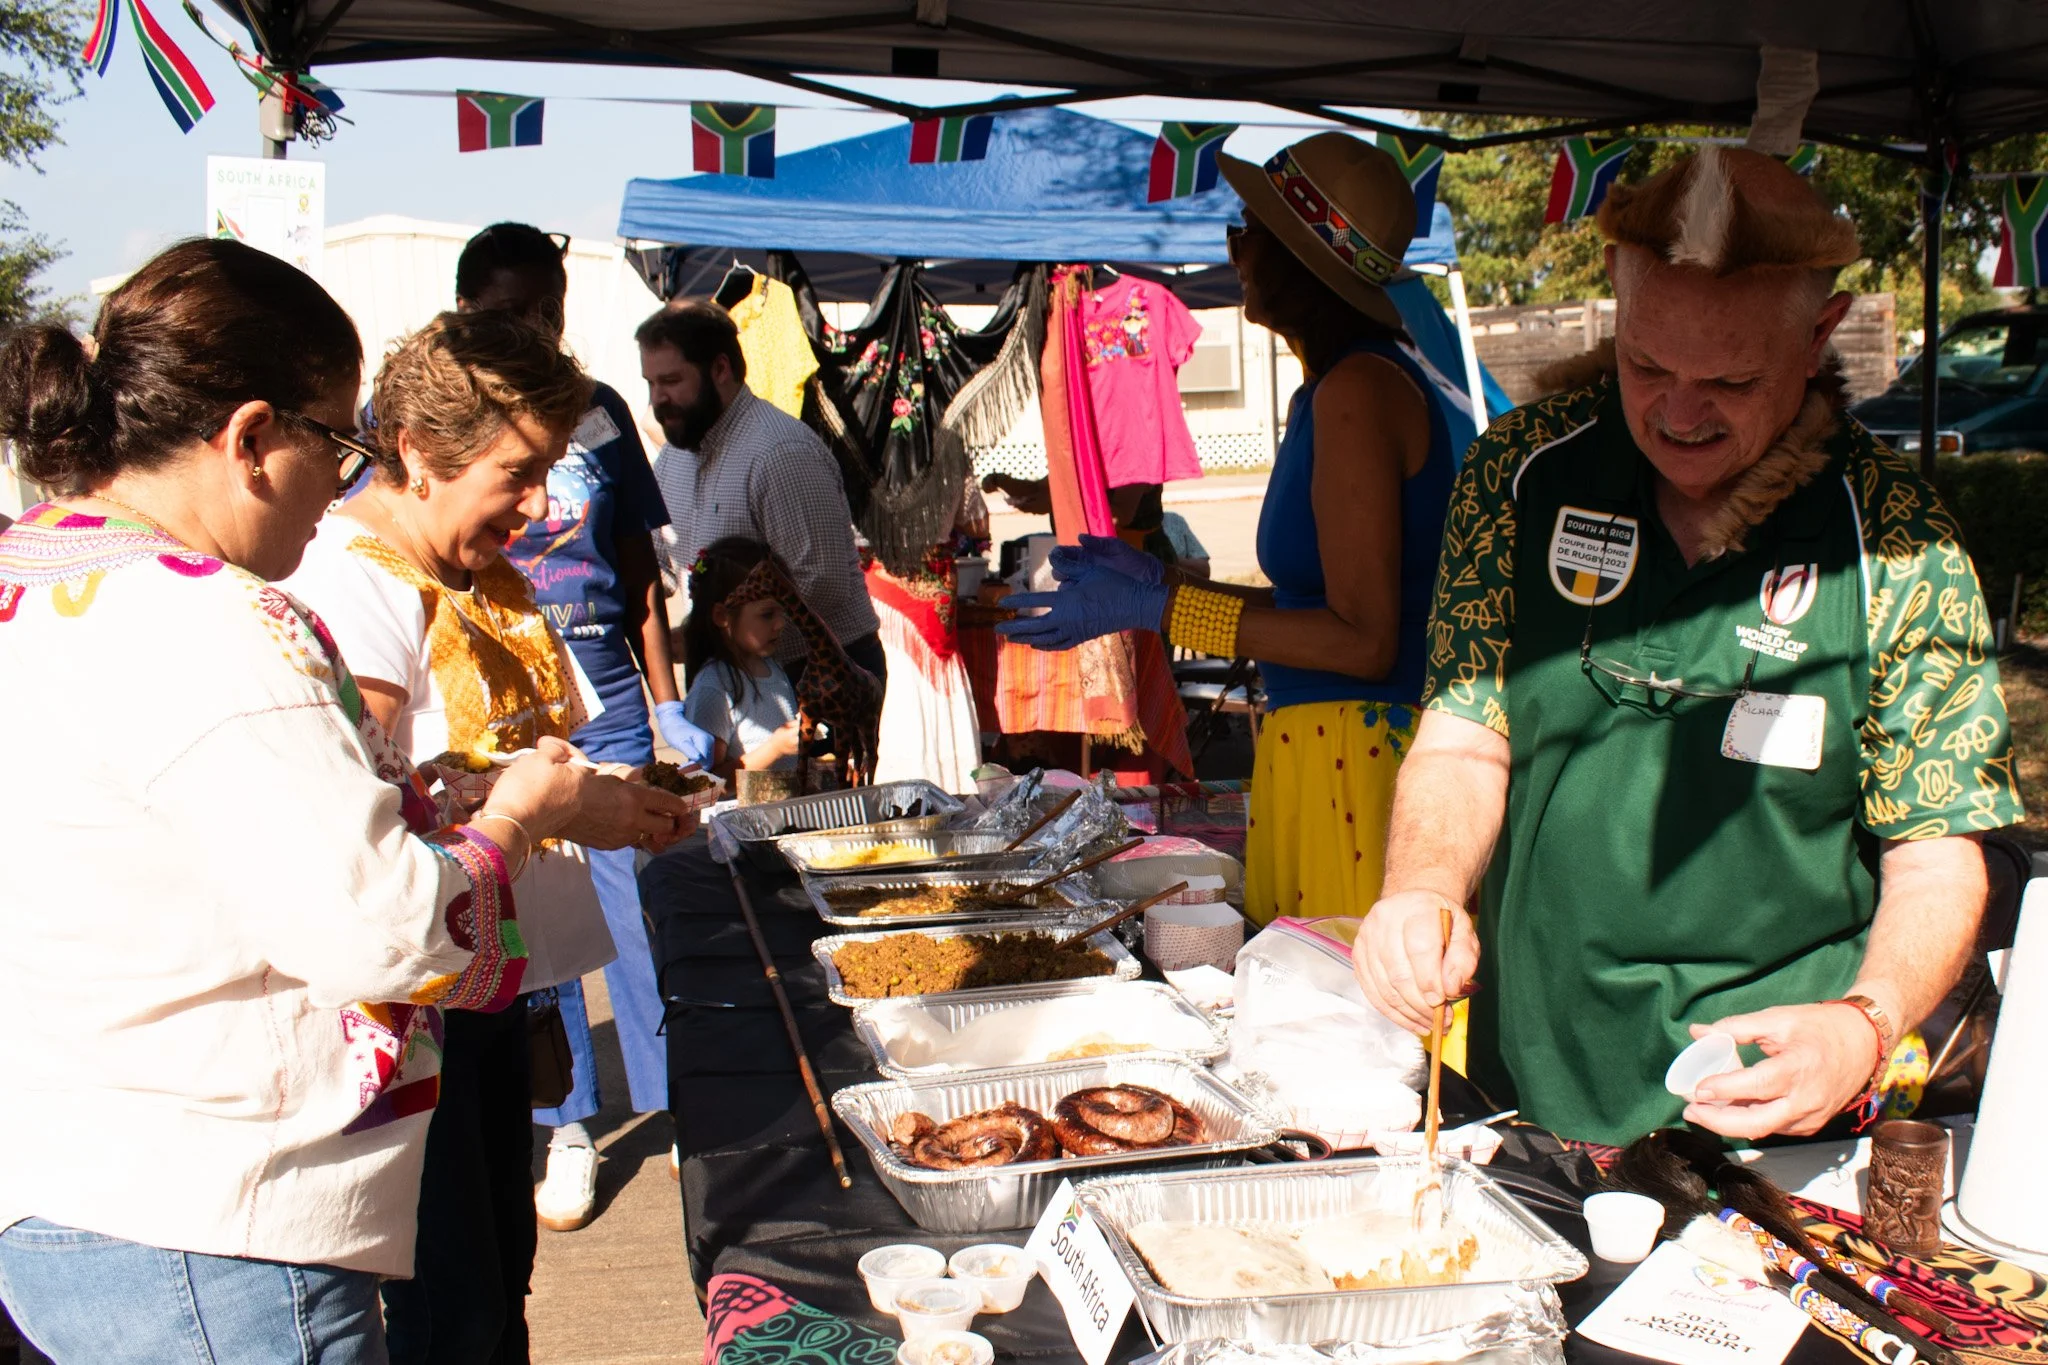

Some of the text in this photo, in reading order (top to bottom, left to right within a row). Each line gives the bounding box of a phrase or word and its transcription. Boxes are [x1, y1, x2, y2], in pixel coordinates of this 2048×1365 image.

[217, 169, 316, 190] SOUTH AFRICA
[545, 499, 583, 521] 025
[1566, 520, 1597, 534] SOUTH
[1559, 537, 1586, 549] COUPE
[1586, 544, 1599, 552] DU
[1557, 546, 1570, 556] DE
[1605, 557, 1627, 569] 2023
[531, 561, 593, 591] ational
[1736, 625, 1809, 654] WORLD CUP
[1740, 699, 1784, 717] RICHAR
[1050, 1222, 1110, 1333] South Africa
[1650, 1315, 1741, 1341] WORLD
[1676, 1311, 1729, 1329] 2025
[1624, 1317, 1757, 1354] PASSPORT
